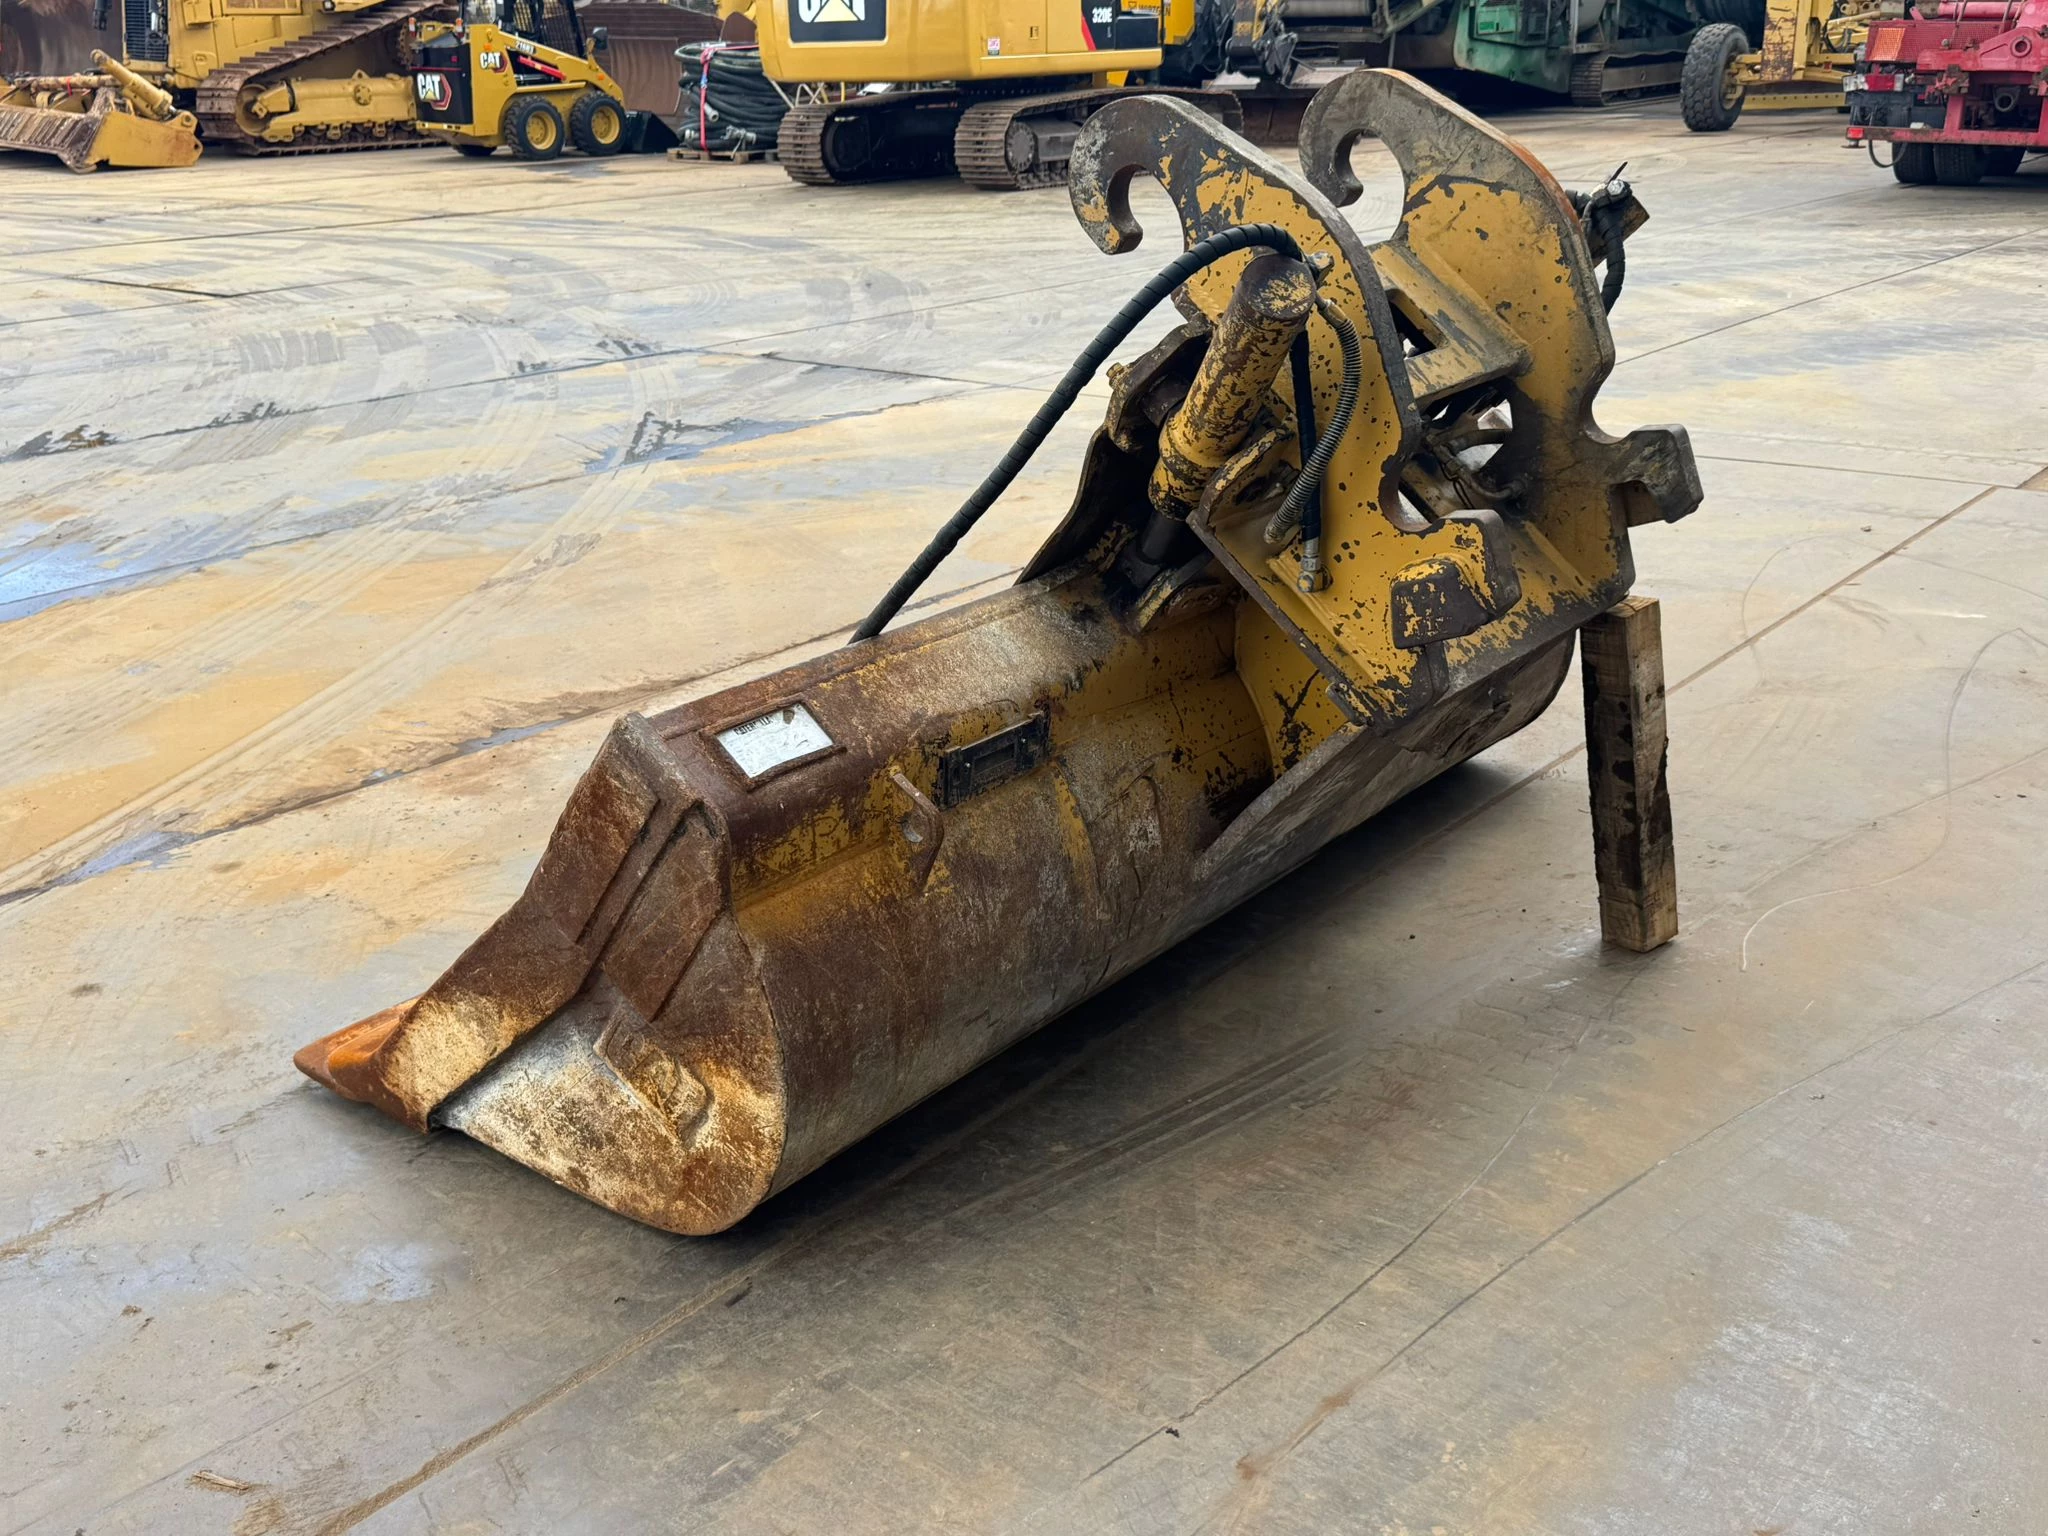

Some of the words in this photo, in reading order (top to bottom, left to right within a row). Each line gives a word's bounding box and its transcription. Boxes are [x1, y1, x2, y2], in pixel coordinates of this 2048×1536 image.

[1092, 7, 1113, 23] 320E
[480, 53, 501, 69] CAT
[417, 73, 441, 101] CAT
